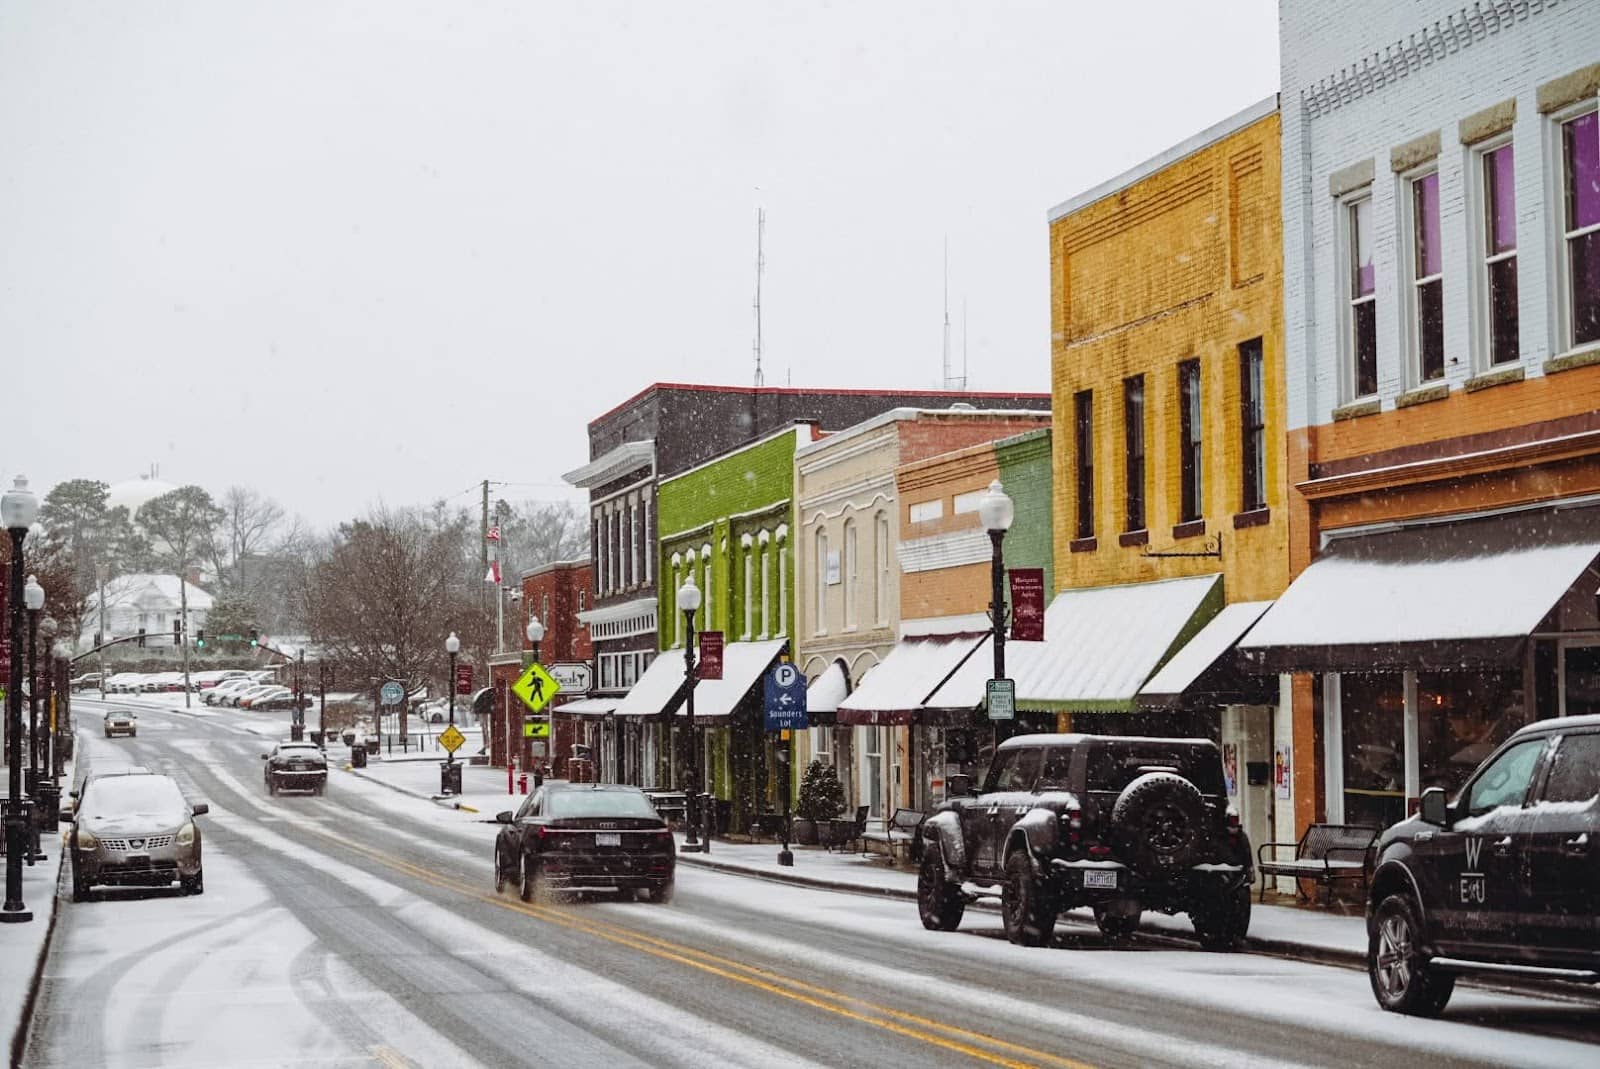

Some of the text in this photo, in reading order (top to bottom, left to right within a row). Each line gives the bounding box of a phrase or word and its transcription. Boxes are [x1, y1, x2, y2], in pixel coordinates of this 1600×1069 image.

[780, 668, 792, 683] P
[769, 710, 803, 718] Saunders
[779, 719, 792, 728] Lot
[1465, 837, 1483, 869] W
